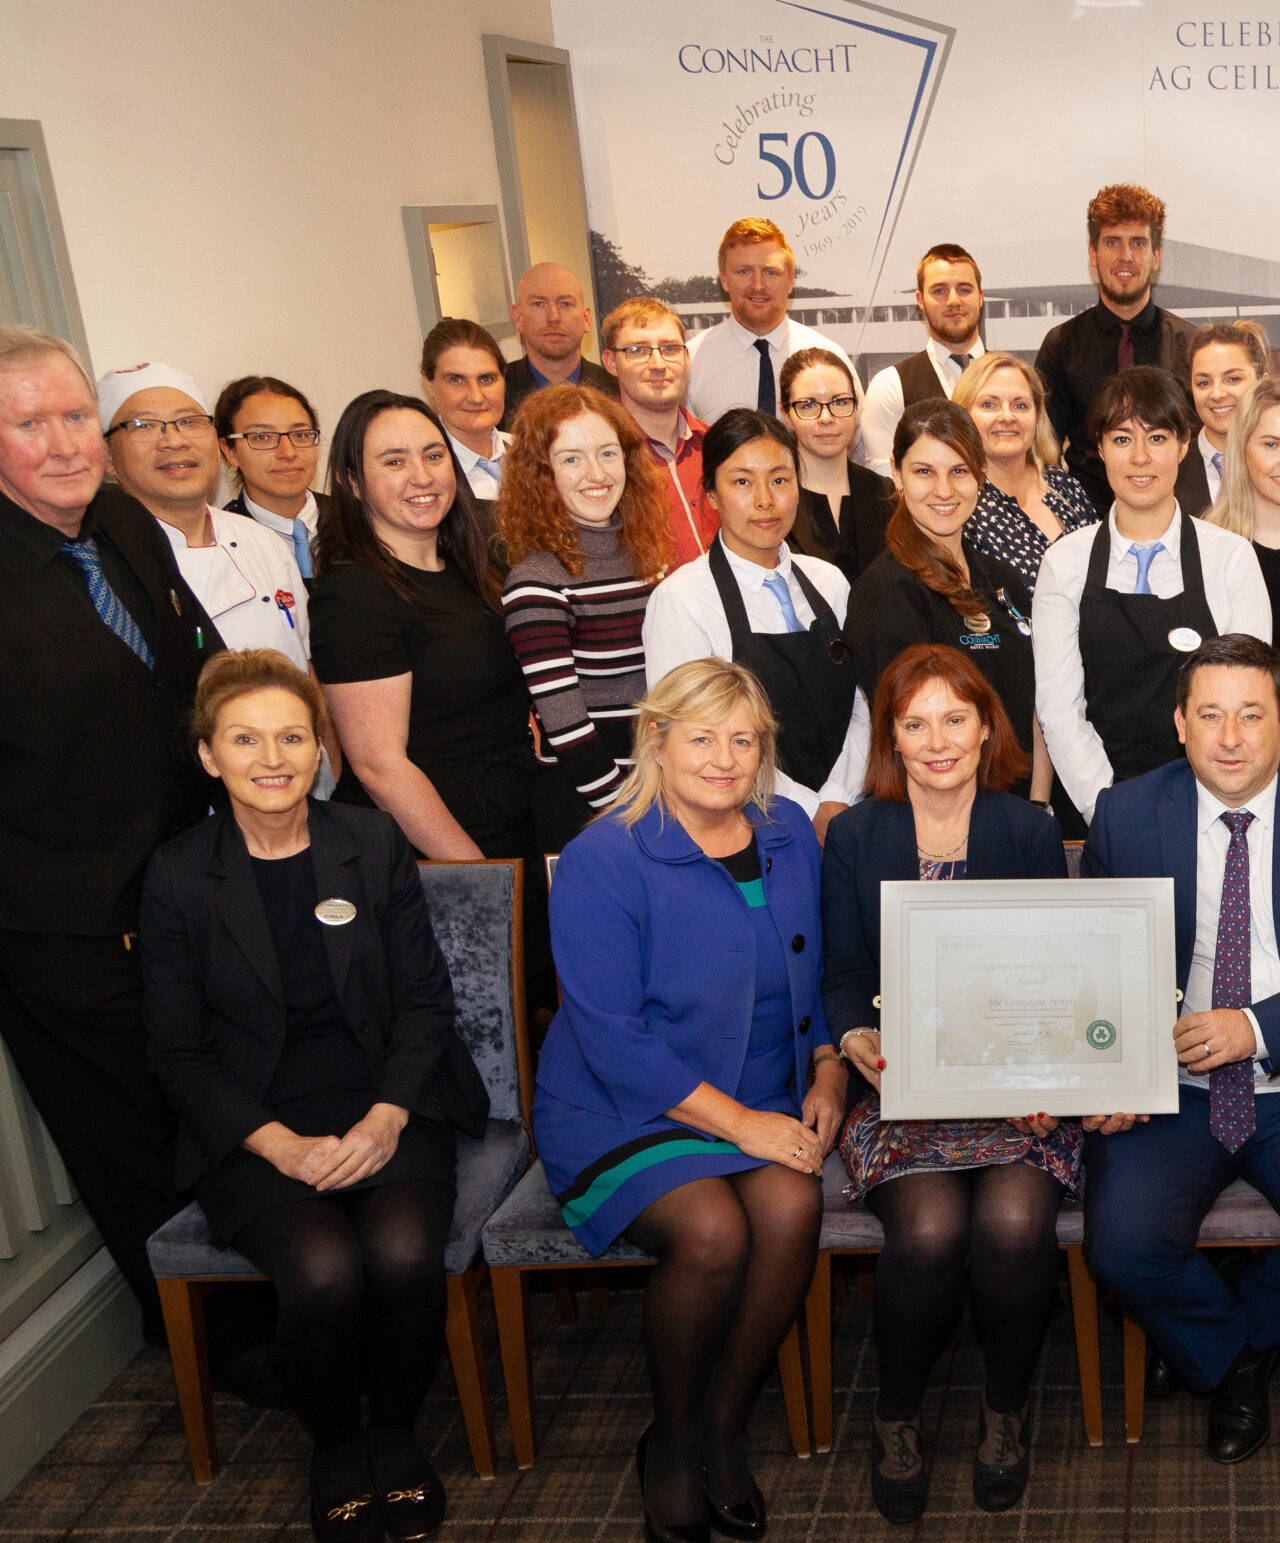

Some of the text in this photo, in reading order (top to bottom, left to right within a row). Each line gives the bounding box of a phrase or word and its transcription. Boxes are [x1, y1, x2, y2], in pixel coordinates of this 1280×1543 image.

[678, 44, 858, 74] CONNACHT
[759, 35, 775, 43] THE
[1148, 65, 1192, 91] AG
[714, 86, 817, 165] Celebrating
[757, 131, 836, 200] 50
[795, 190, 848, 238] years
[803, 236, 833, 257] 1969
[841, 205, 868, 236] 2019
